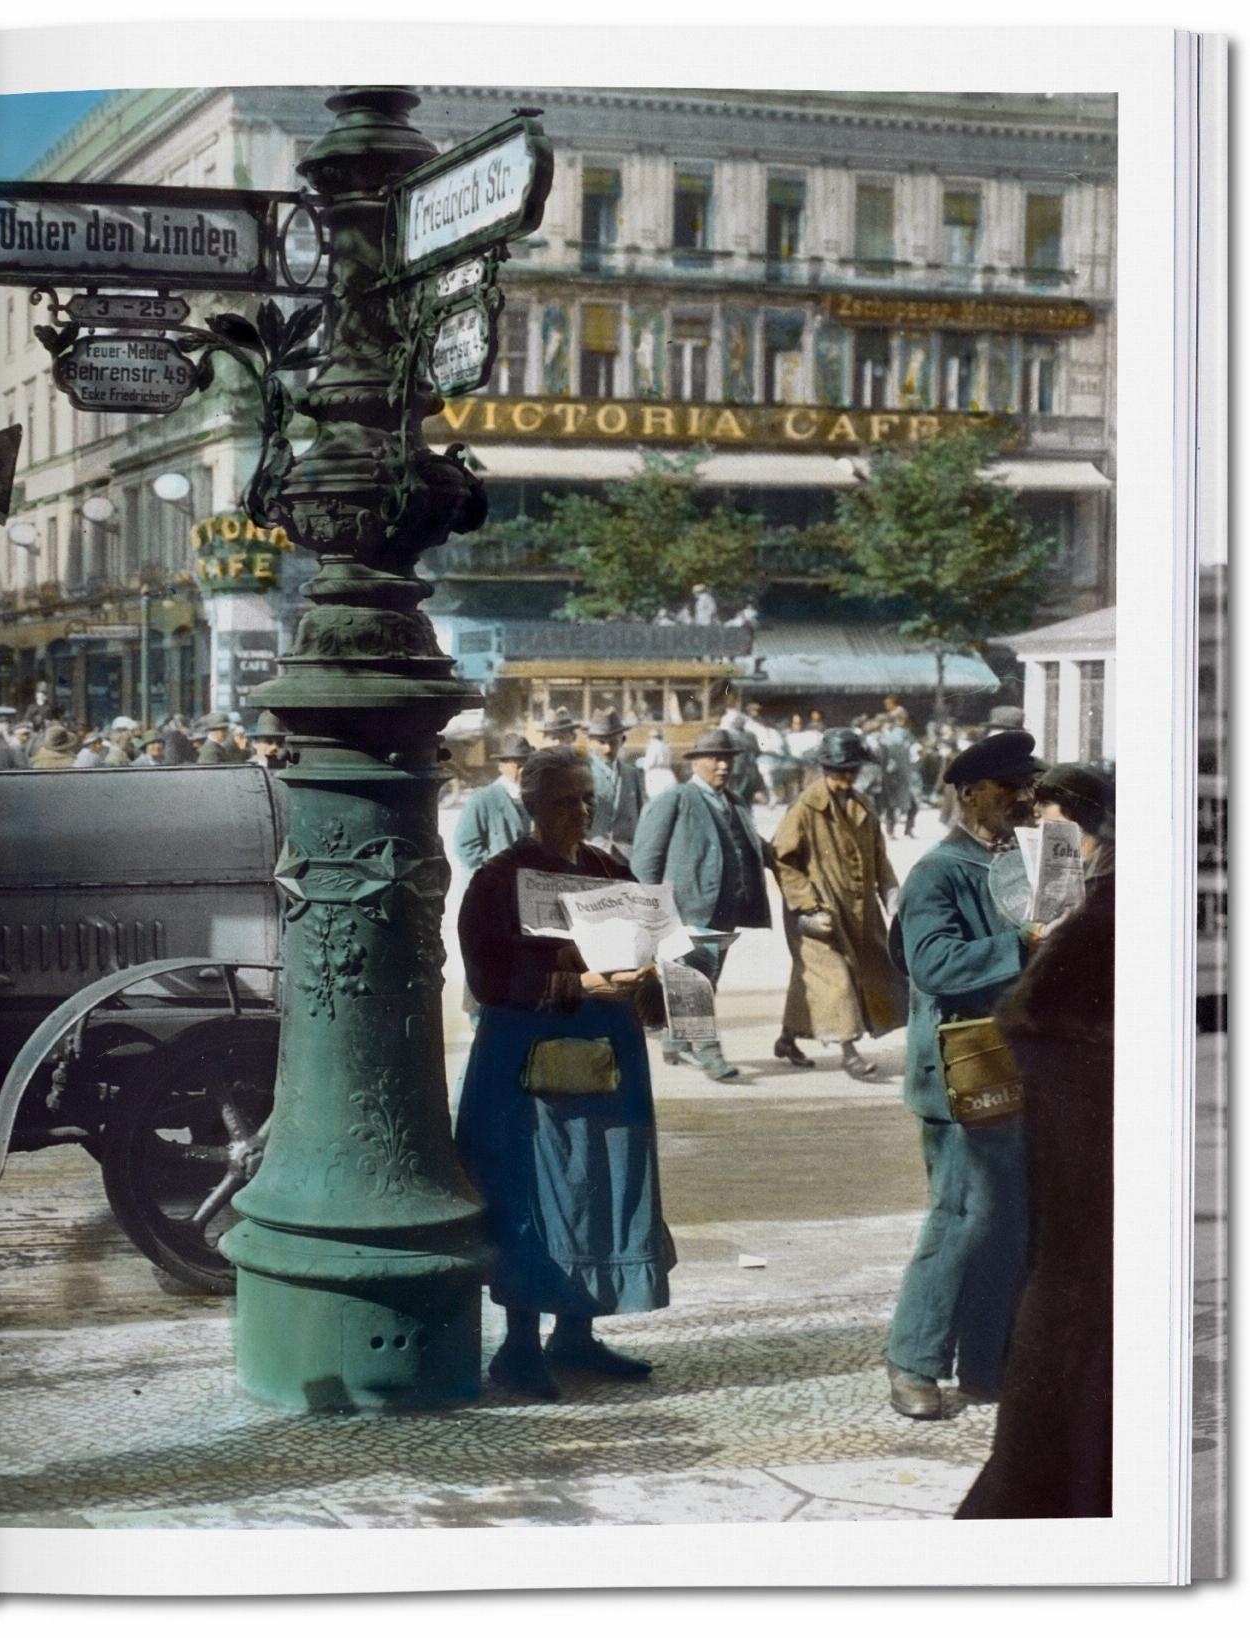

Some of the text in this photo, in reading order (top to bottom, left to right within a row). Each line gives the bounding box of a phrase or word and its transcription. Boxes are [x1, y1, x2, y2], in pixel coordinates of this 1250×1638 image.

[86, 209, 135, 252] den
[143, 211, 238, 258] Linden
[139, 301, 166, 317] 25
[85, 340, 170, 361] Feuer-Melder
[65, 362, 188, 385] Behrenstr. 49
[82, 387, 106, 401] Ecke
[442, 398, 746, 437] VICTORIA
